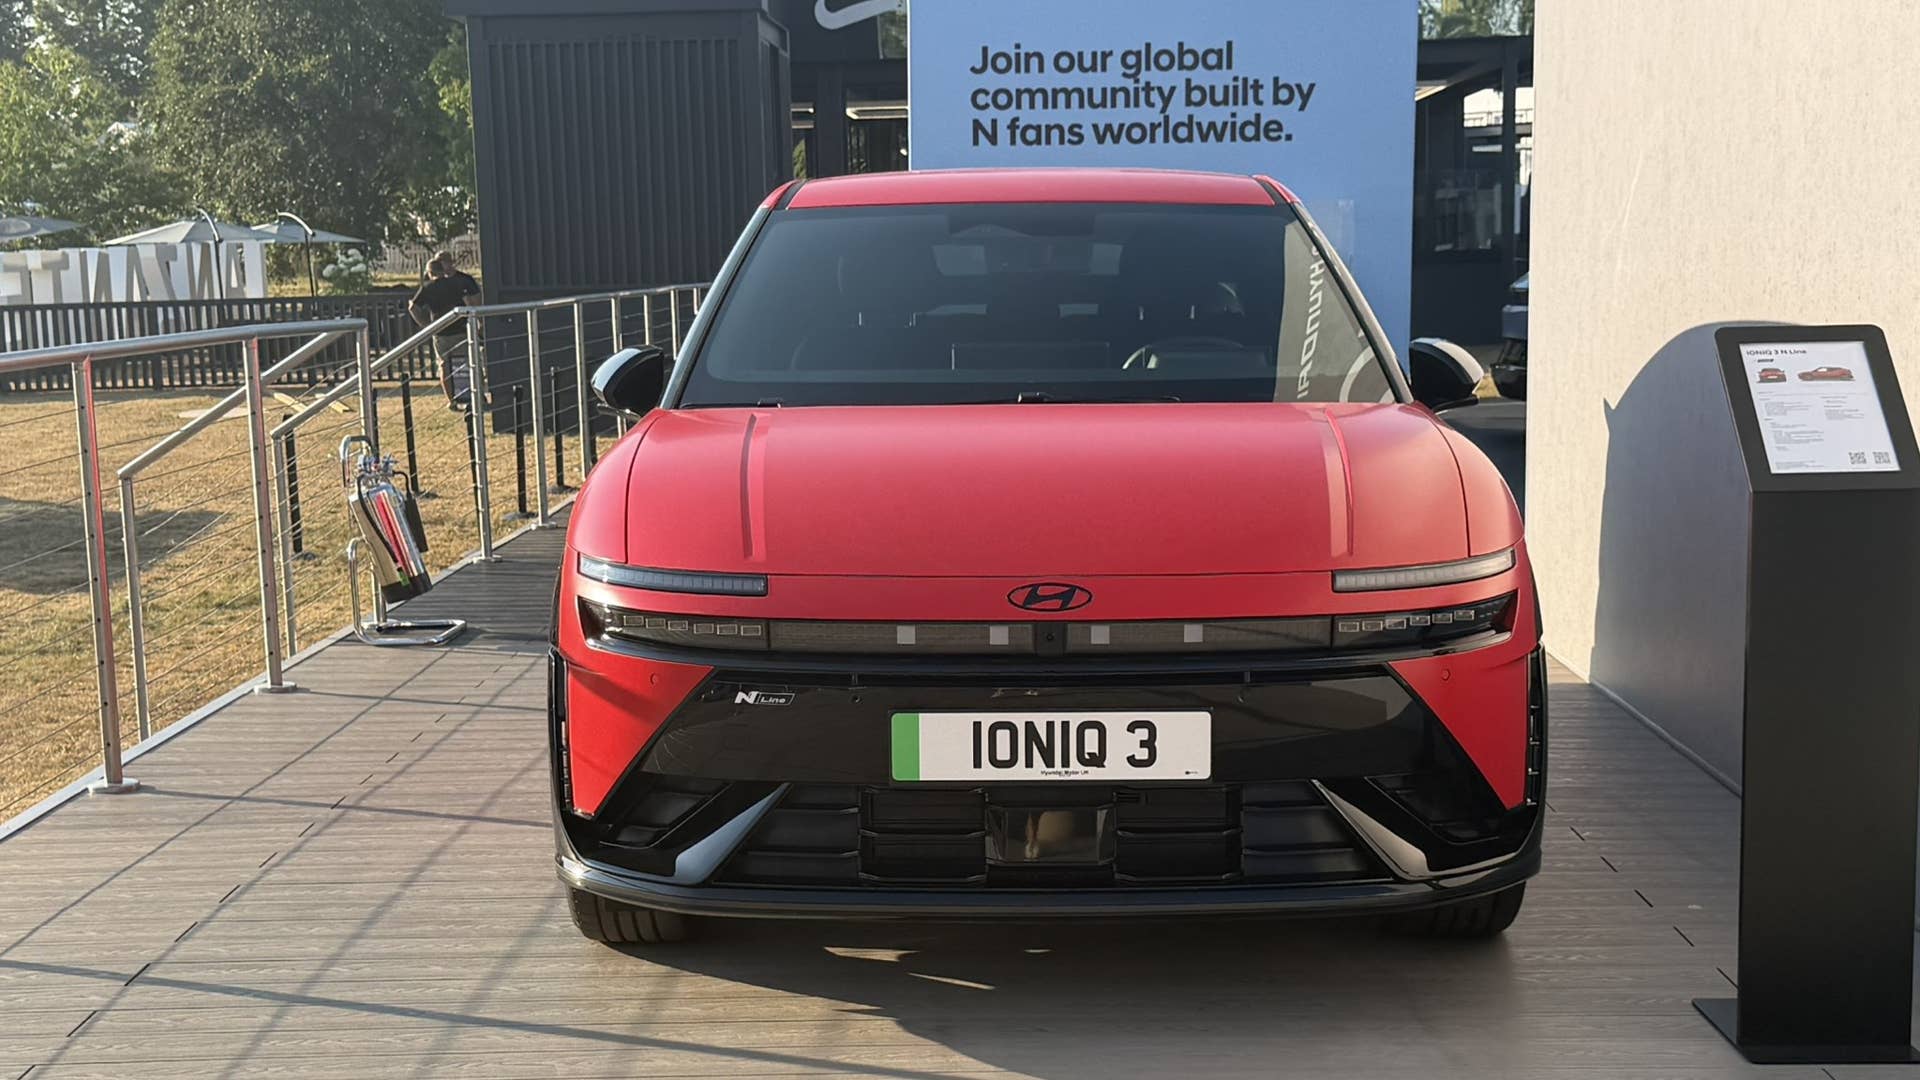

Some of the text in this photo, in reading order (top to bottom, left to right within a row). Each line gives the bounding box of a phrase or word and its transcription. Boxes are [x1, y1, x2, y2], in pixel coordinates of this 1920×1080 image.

[969, 40, 1234, 79] Join our global
[970, 76, 1316, 114] community built by
[972, 112, 1294, 147] N fans worldwide.
[734, 691, 786, 704] N Line
[972, 720, 1157, 769] IONIQ 3
